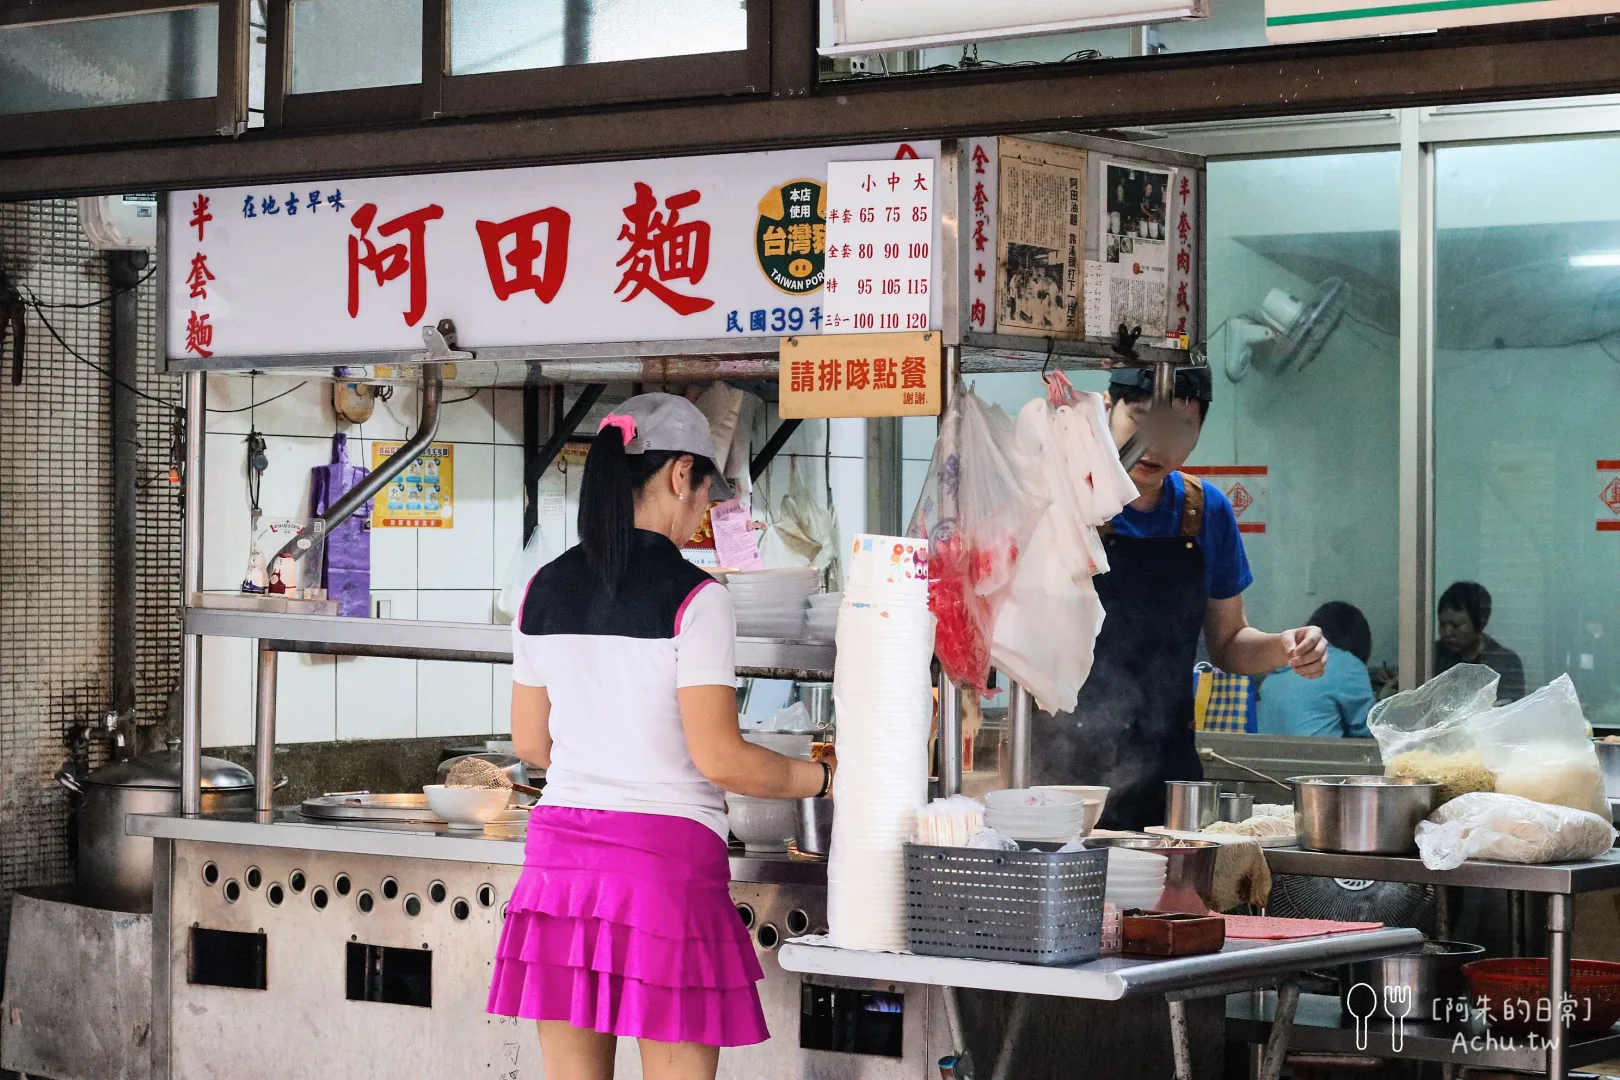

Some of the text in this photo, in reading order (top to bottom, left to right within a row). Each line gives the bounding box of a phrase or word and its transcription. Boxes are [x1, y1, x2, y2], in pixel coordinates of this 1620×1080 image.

[861, 172, 928, 193] 小 中 大
[241, 188, 346, 218] 在地古早味
[789, 188, 811, 202] 本店
[789, 205, 811, 219] 使用
[829, 206, 928, 224] 半套 65 75 85
[348, 180, 715, 328] 阿田麵
[827, 243, 929, 259] 全套 80 90 100
[185, 194, 216, 358] 半套麵
[770, 268, 804, 290] TAIWAN
[826, 278, 928, 295] 特 95 105 115
[853, 313, 874, 329] 100
[880, 313, 899, 329] 110
[906, 313, 927, 329] 120
[790, 355, 927, 393] 請排隊點餐
